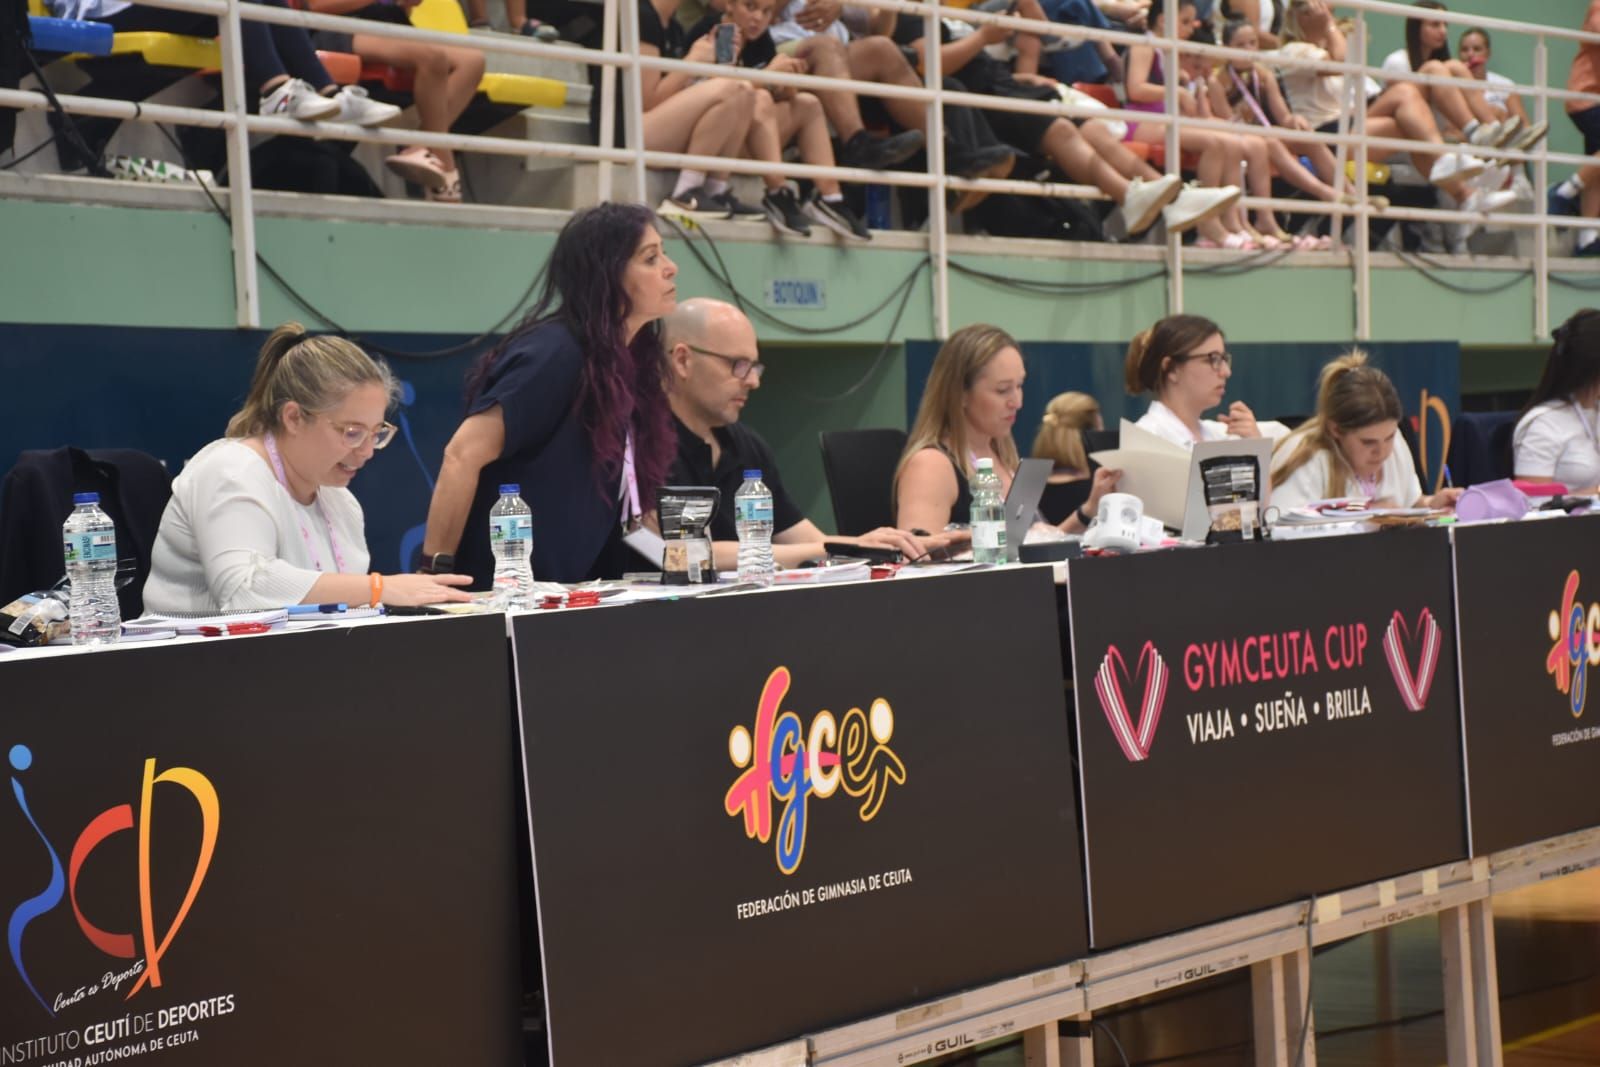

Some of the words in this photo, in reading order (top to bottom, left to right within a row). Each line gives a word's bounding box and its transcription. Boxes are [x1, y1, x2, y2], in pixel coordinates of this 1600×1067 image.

[1183, 629, 1319, 692] GYMCEUTA
[1324, 622, 1369, 672] CUP
[1186, 708, 1235, 744] VIAJA
[1254, 691, 1308, 733] SUEÑA
[1326, 685, 1372, 721] BRILLA
[736, 889, 800, 920] FEDERACIÓN
[802, 888, 815, 906] DE
[817, 877, 867, 902] GIMNASIA
[868, 874, 881, 891] DE
[883, 867, 913, 888] CEUTA
[53, 986, 86, 1012] Ceuta
[87, 985, 99, 996] es
[101, 959, 145, 991] Deporte
[1184, 964, 1217, 980] GUIL
[84, 1013, 131, 1046] CEUTÍ
[133, 1012, 155, 1035] DE
[157, 994, 235, 1029] DEPORTES
[935, 1034, 974, 1052] GUIL
[85, 1044, 148, 1065] AUTÓNOMA
[150, 1038, 164, 1051] DE
[166, 1029, 200, 1047] CEUTA
